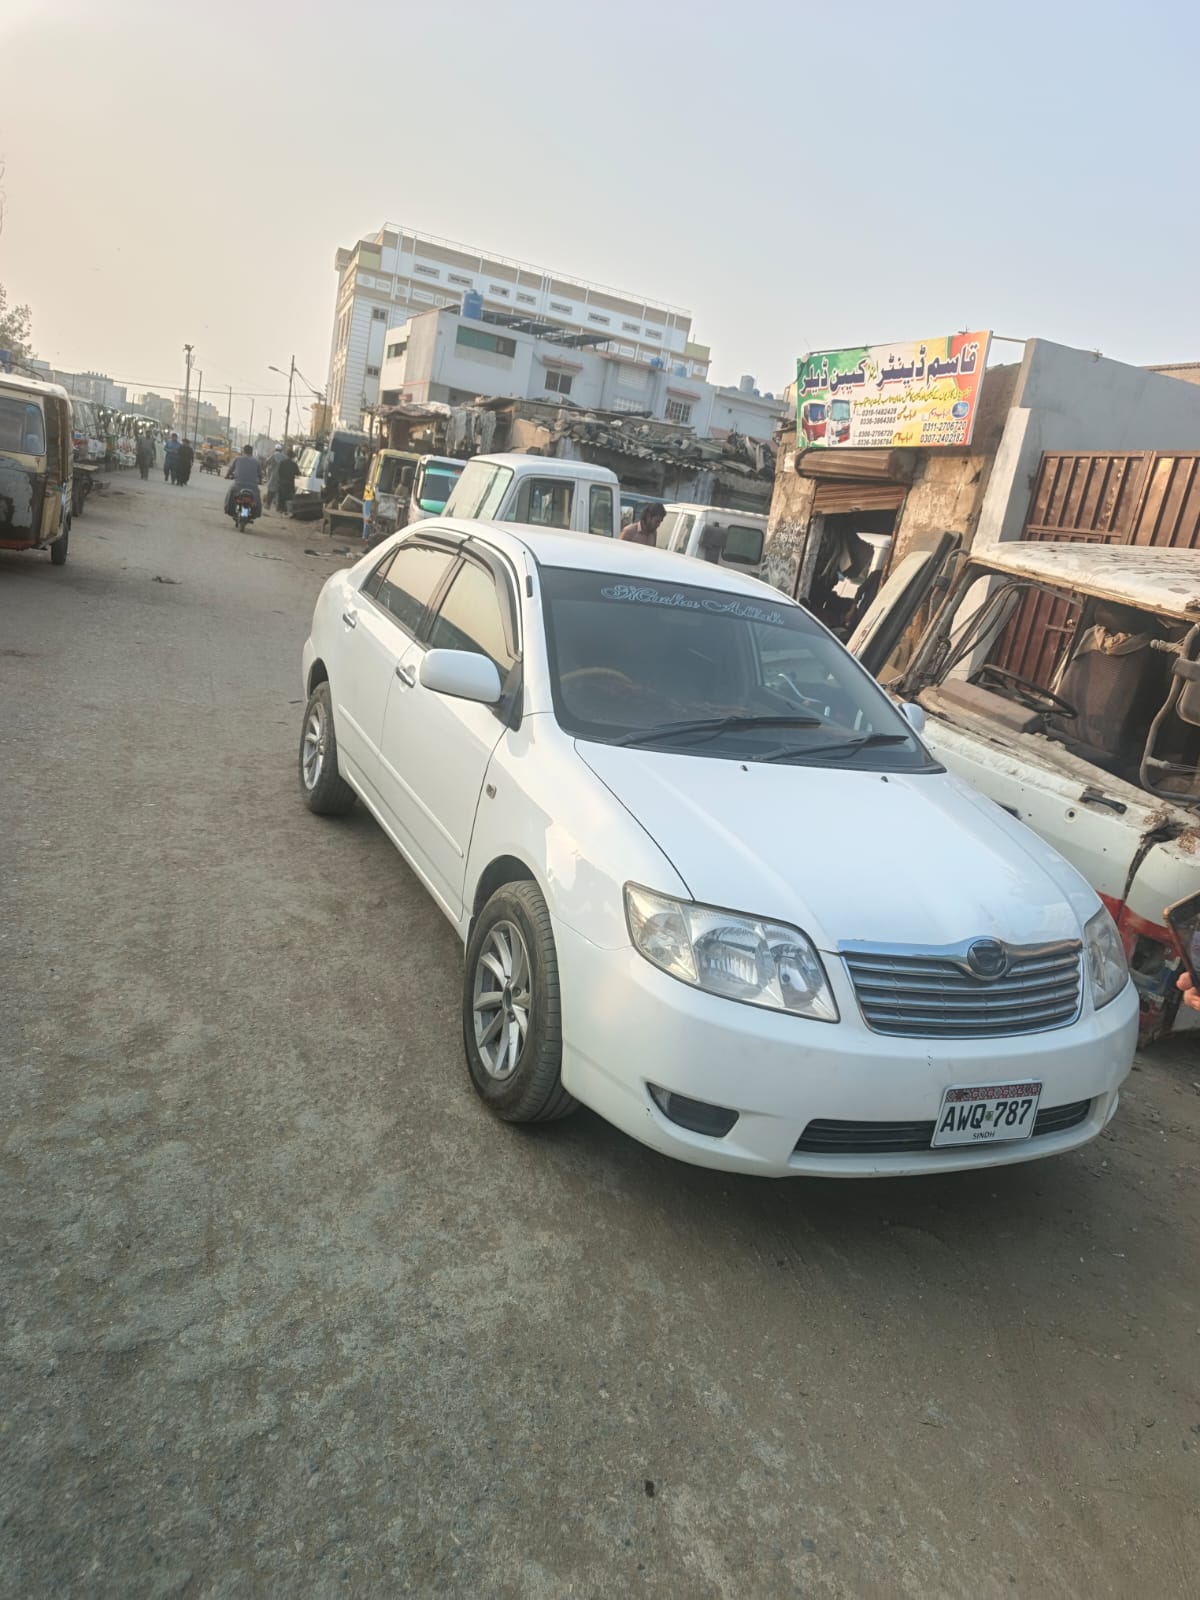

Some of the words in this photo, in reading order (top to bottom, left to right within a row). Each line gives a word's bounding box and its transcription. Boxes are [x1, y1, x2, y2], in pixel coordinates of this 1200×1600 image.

[800, 358, 828, 396] ڈیلر
[829, 357, 868, 393] کیبن
[926, 343, 977, 386] قاسم
[939, 1103, 987, 1132] AWQ
[993, 1099, 1033, 1128] 787
[972, 1131, 995, 1139] SINDH
